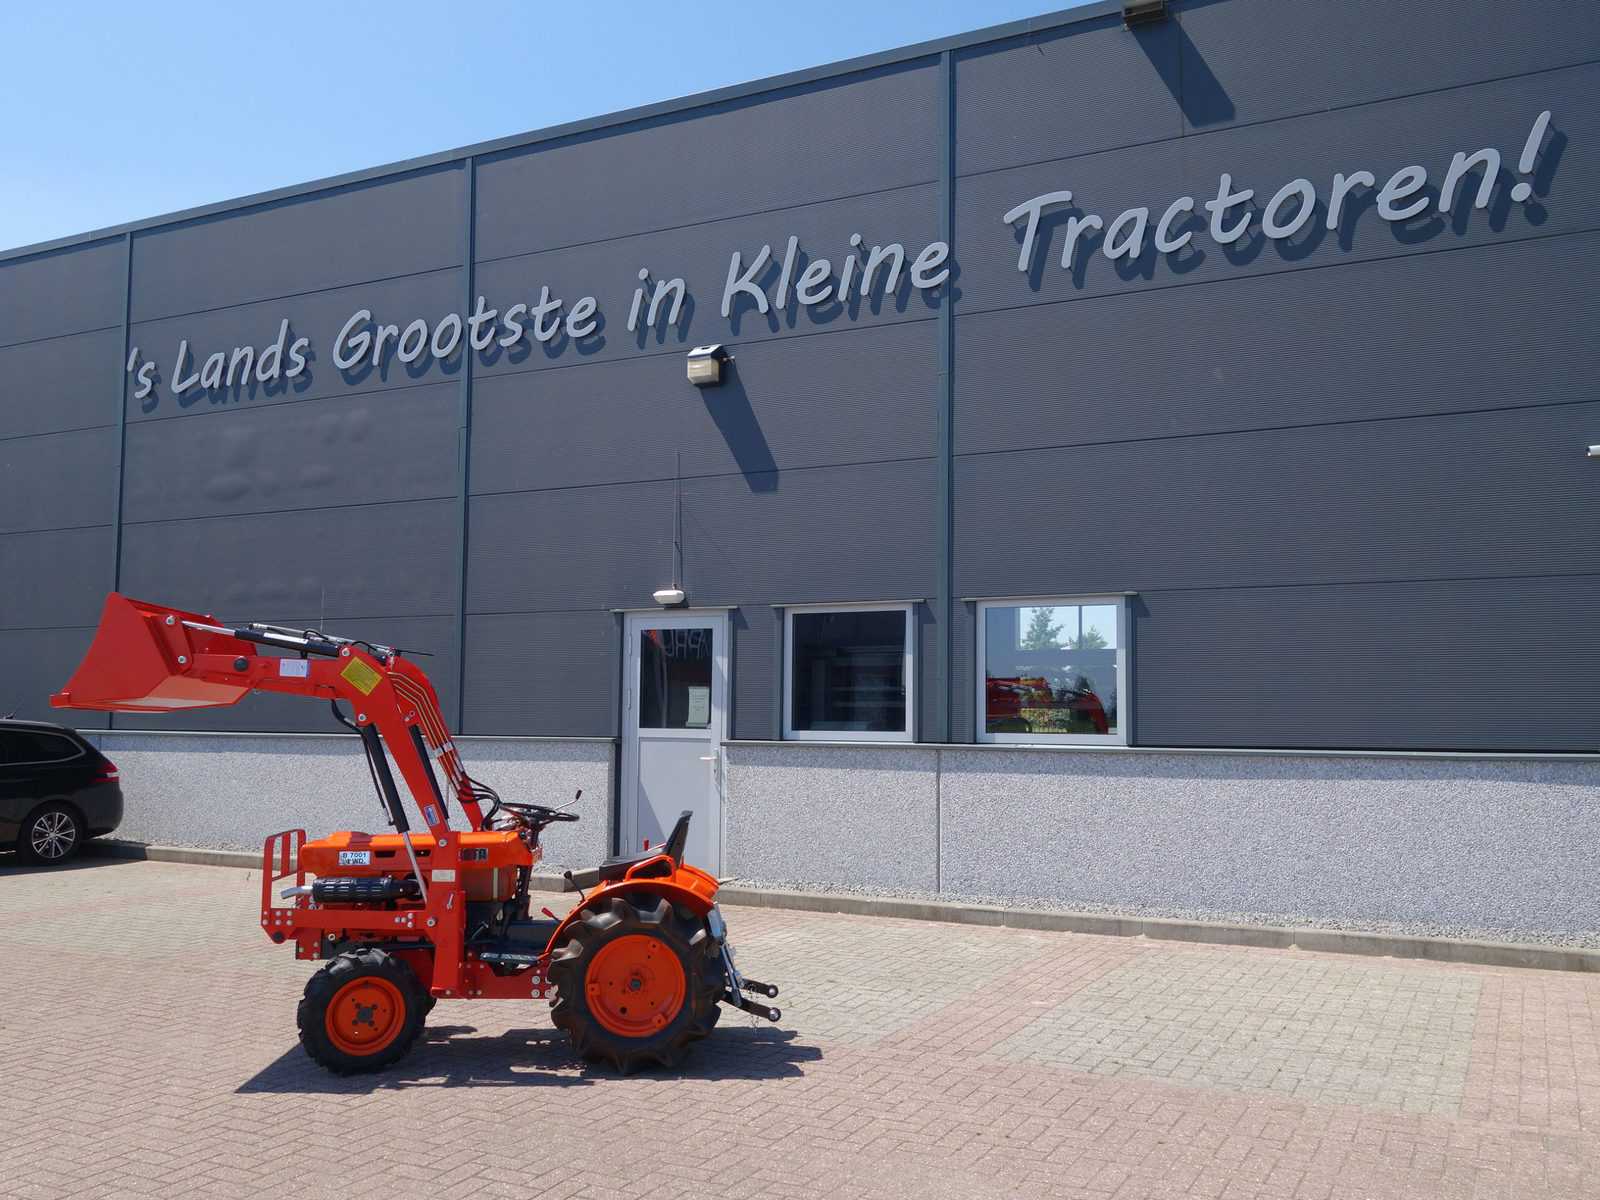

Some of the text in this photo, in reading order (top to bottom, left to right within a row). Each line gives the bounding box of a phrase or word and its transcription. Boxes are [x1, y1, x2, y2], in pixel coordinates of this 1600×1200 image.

[126, 110, 1552, 399] 's Lands Grootste in Kleine Tractoren!
